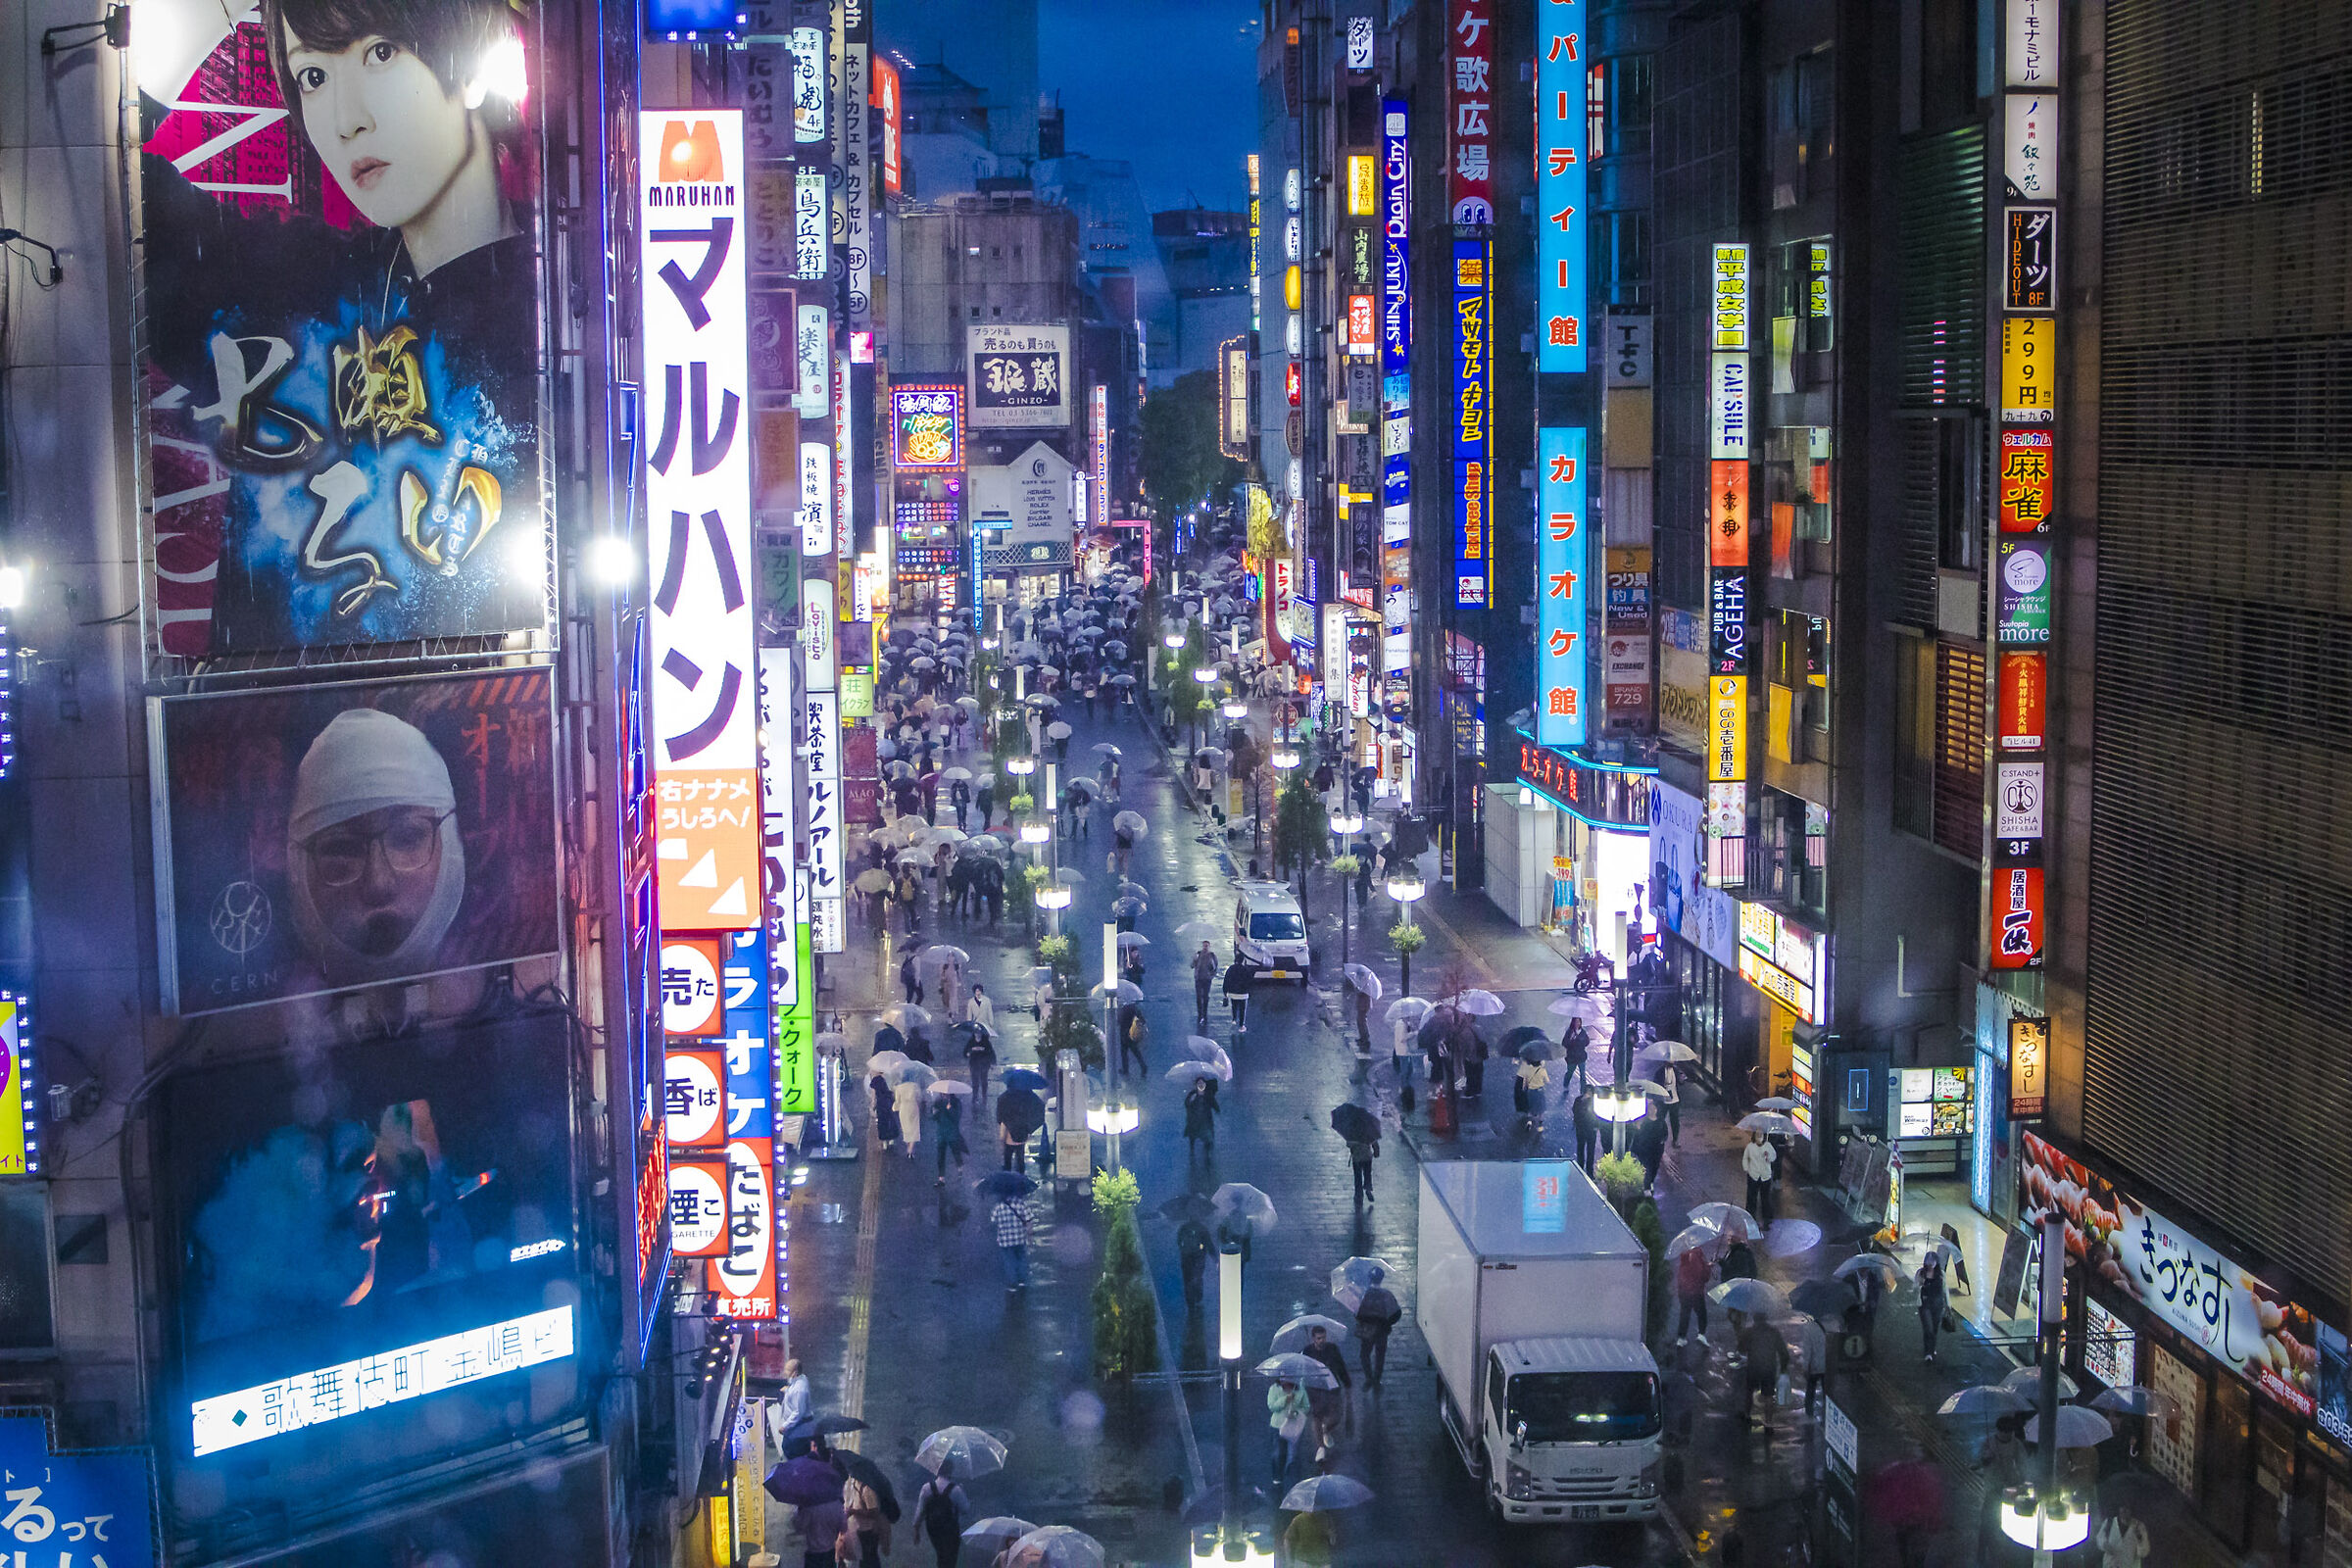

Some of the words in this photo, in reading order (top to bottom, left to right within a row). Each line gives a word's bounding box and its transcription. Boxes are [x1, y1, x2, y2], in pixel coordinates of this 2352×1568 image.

[1352, 21, 1368, 65] ダーツ
[2025, 0, 2039, 81] 1モナミビル
[1456, 10, 1490, 181] ケ歌広場
[807, 114, 821, 127] 4F
[798, 166, 817, 175] 5F
[1547, 0, 1579, 346] パーティー館
[649, 185, 735, 207] MARUHAN
[2013, 213, 2023, 306] HIDEOUT
[2025, 212, 2051, 288] ダーツ
[2029, 291, 2045, 306] 8F
[984, 337, 1025, 351] 売るのも
[2019, 318, 2037, 405] 299円
[1724, 364, 1743, 447] CAPSULE
[2005, 411, 2038, 421] 九十九
[2002, 432, 2052, 447] ウェルカム
[648, 217, 746, 762] マルハン
[2002, 450, 2050, 521] 麻雀
[2036, 520, 2052, 534] 6F
[2000, 542, 2015, 554] 5F
[1547, 455, 1579, 717] カラオケ館
[1608, 572, 1649, 587] つり具
[1714, 579, 1725, 601] BAR
[1715, 601, 1725, 611] &
[1714, 610, 1725, 632] PUB
[1725, 575, 1744, 660] AGEHA
[1999, 627, 2051, 642] more
[1720, 660, 1737, 672] 2F
[1614, 693, 1642, 705] 729
[660, 778, 751, 803] 右ナナメ
[1662, 800, 1693, 834] OKURA
[2001, 816, 2038, 825] SHISHA
[2008, 840, 2031, 856] 3F
[2011, 869, 2027, 910] 居酒屋
[2001, 909, 2034, 956] 一休
[696, 978, 714, 996] た
[724, 926, 766, 1137] ラオケ
[698, 1088, 717, 1106] ば
[704, 1199, 720, 1216] こ
[721, 1162, 761, 1276] たばこ
[2140, 1215, 2246, 1363] きづなすし
[715, 1298, 771, 1317] 直売所
[263, 1348, 430, 1434] 歌舞伎町
